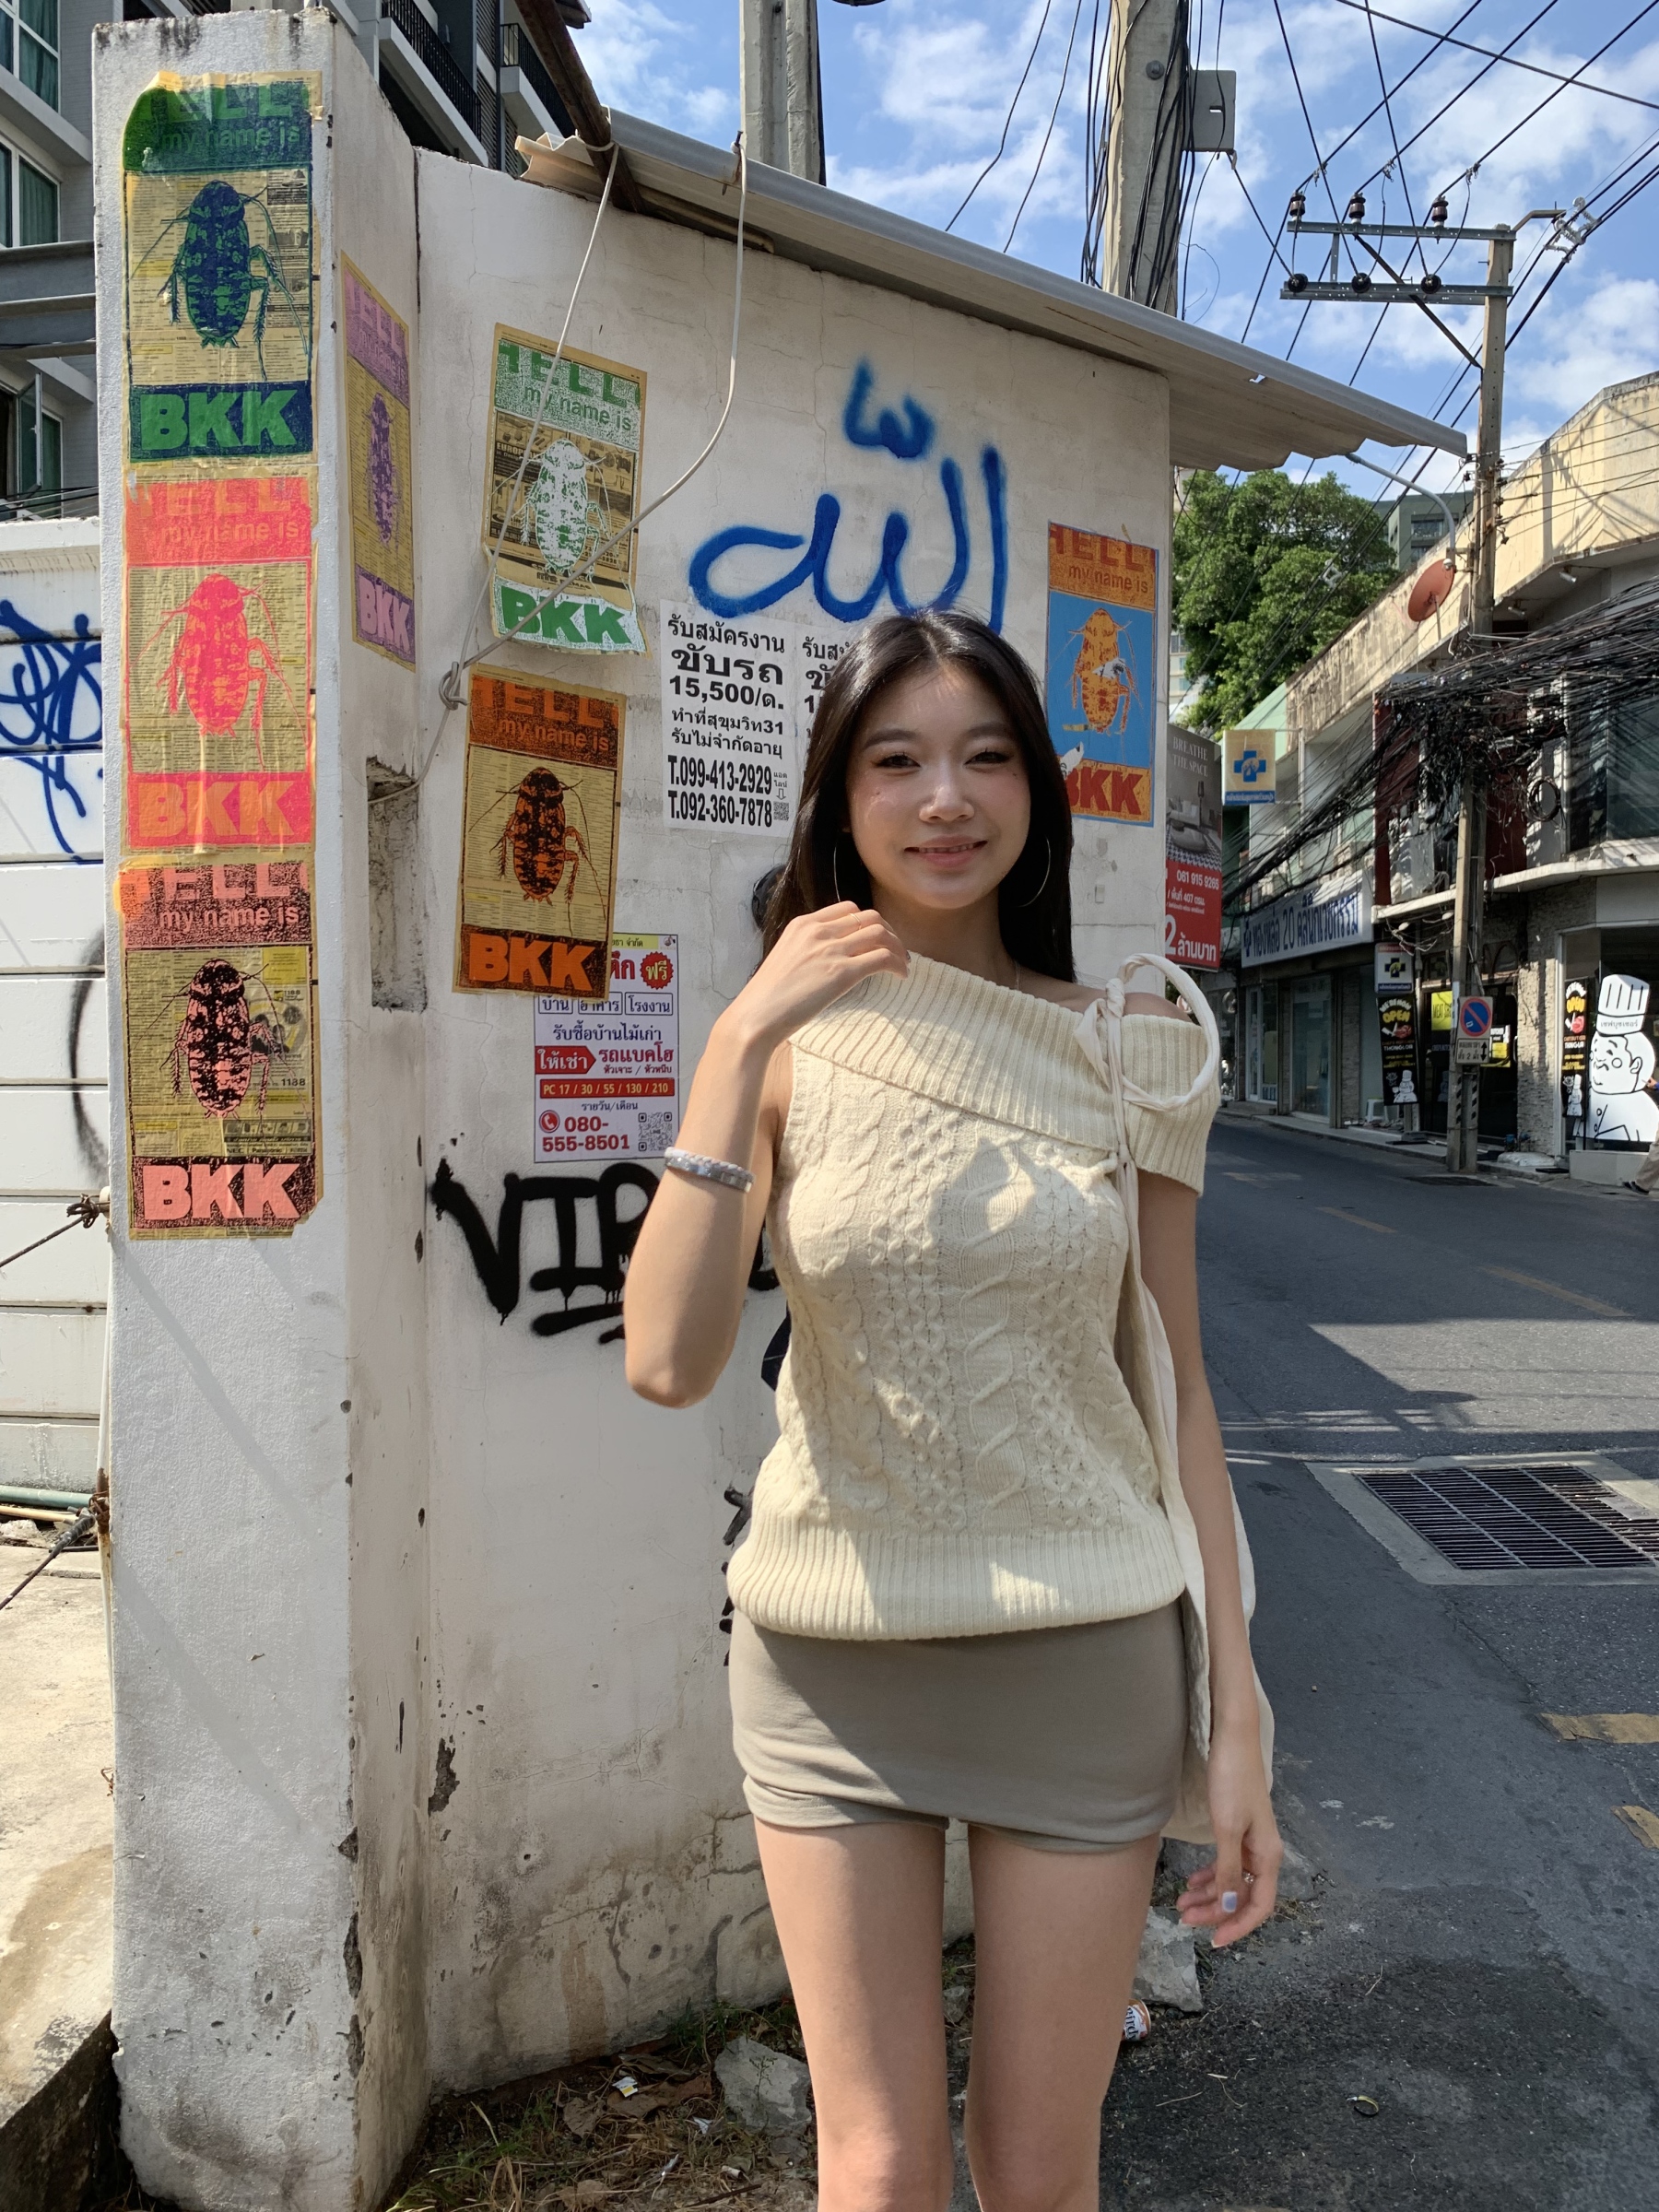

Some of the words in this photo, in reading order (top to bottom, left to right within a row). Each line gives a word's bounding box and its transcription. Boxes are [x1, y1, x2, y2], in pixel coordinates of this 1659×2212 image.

[161, 132, 197, 154] my
[206, 126, 270, 147] name
[279, 121, 300, 148] is
[140, 388, 300, 452] BKK
[560, 394, 610, 425] name
[616, 411, 632, 432] is
[161, 525, 200, 546] my
[205, 519, 270, 543] name
[277, 517, 300, 540] is
[1069, 565, 1089, 581] my
[1095, 571, 1132, 591] name
[1136, 575, 1148, 594] is
[359, 573, 411, 652] BKK
[500, 585, 632, 644] BKK
[668, 614, 784, 653] รับสมัครงาน
[671, 642, 783, 685] ขับรถ
[499, 718, 529, 741] my
[536, 724, 588, 748] name
[594, 735, 609, 752] is
[672, 706, 783, 735] ทำที่สุขุมวิท31
[671, 727, 782, 759] รับไม่จำกัดอายุ
[1172, 736, 1208, 761] BREATHE
[668, 754, 772, 795] T.099-413-2929
[1172, 754, 1188, 771] THE
[1189, 760, 1208, 777] SPACE
[137, 779, 295, 838] BKK
[668, 790, 772, 828] T.092-360-7878
[1176, 869, 1190, 884] 061
[1191, 872, 1203, 887] 915
[1183, 892, 1194, 903] 407
[159, 909, 194, 933] my
[203, 905, 269, 926] name
[278, 902, 300, 924] is
[1283, 906, 1295, 950] 20
[627, 936, 643, 947] จำกัด
[1178, 931, 1217, 961] ล้านบาท
[469, 933, 595, 992] BKK
[645, 959, 668, 981] ฟรี
[628, 995, 671, 1013] โรงงาน
[1382, 1009, 1411, 1023] OPEN
[553, 1020, 663, 1041] รับซื้อบ้านไม้เก่า
[538, 1049, 588, 1070] ให้เช่า
[1466, 1052, 1471, 1060] 2
[281, 1078, 306, 1087] 1188
[543, 1084, 556, 1095] PC
[559, 1084, 571, 1095] 17
[581, 1084, 593, 1095] 30
[604, 1083, 616, 1095] 55
[626, 1083, 642, 1094] 130
[653, 1083, 669, 1094] 210
[564, 1115, 609, 1132] 080-
[542, 1135, 630, 1152] 555-8501
[142, 1162, 300, 1221] BKK
